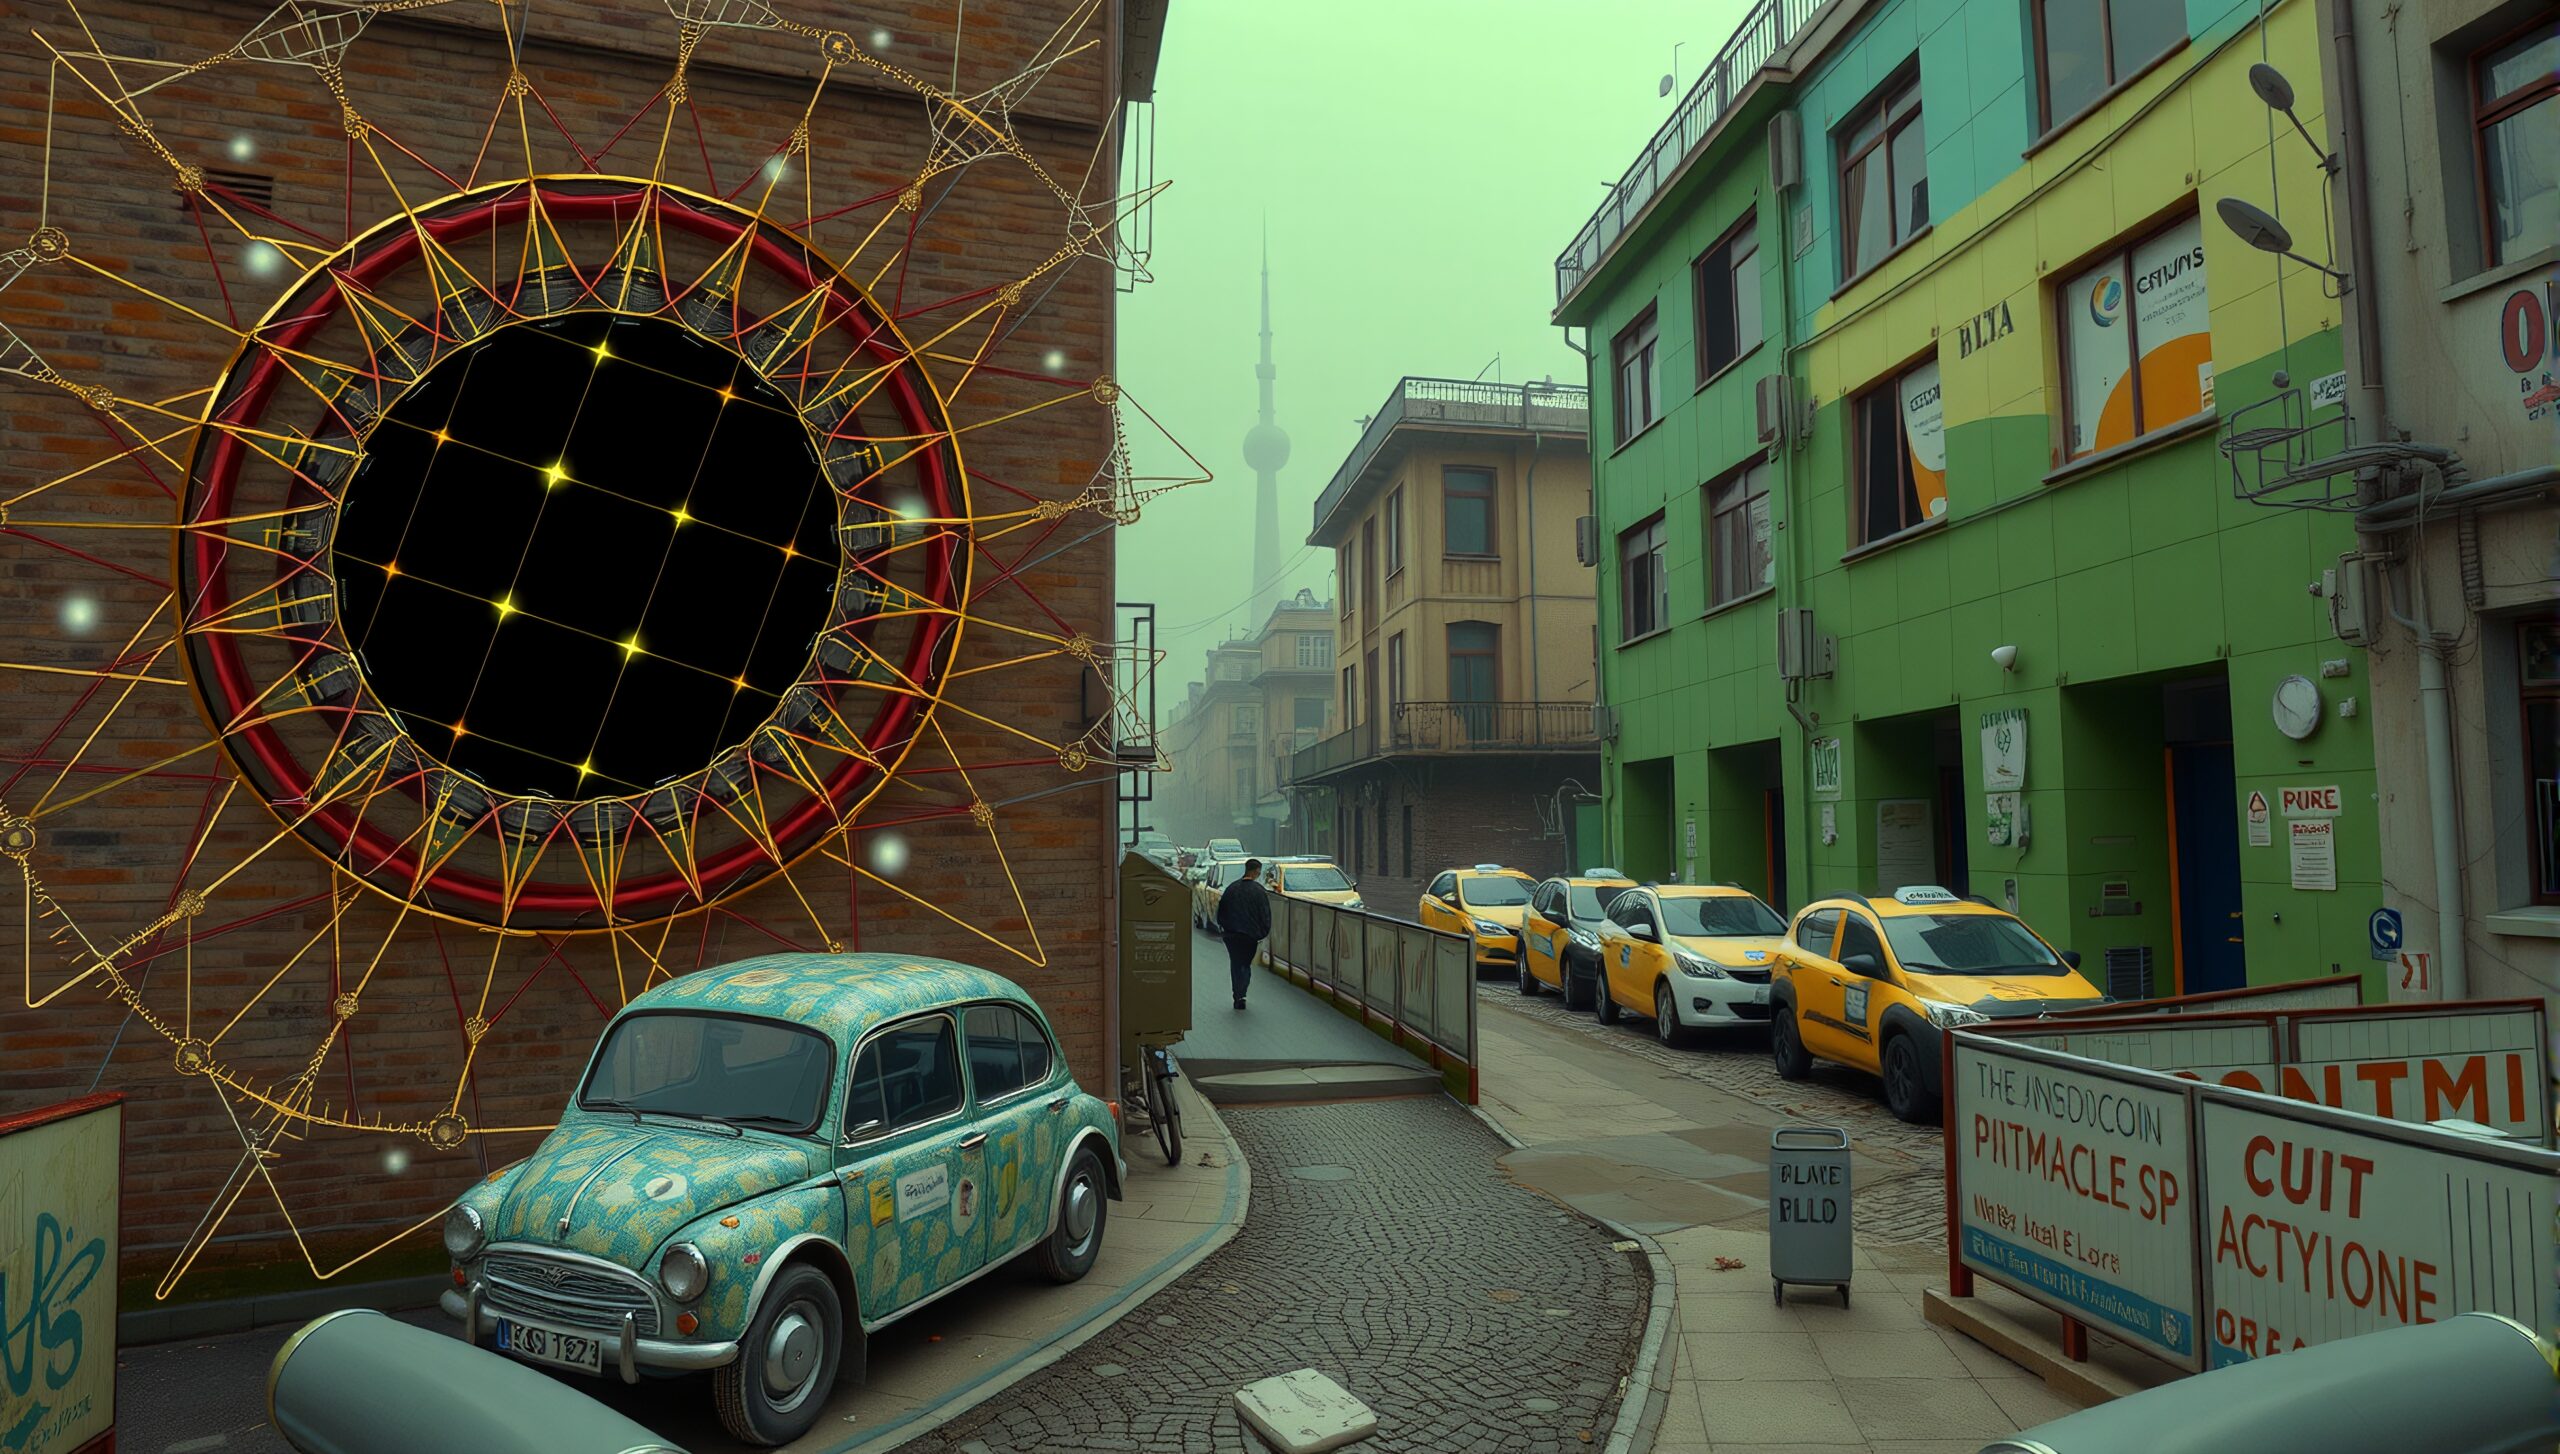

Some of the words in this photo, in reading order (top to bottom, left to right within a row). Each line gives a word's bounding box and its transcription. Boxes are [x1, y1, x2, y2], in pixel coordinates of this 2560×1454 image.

[2283, 789, 2338, 812] PURE
[1976, 1062, 2015, 1105] THE
[2138, 1164, 2179, 1225] SP
[2244, 1135, 2374, 1219] CUIT
[2217, 1205, 2437, 1324] ACTYIONE
